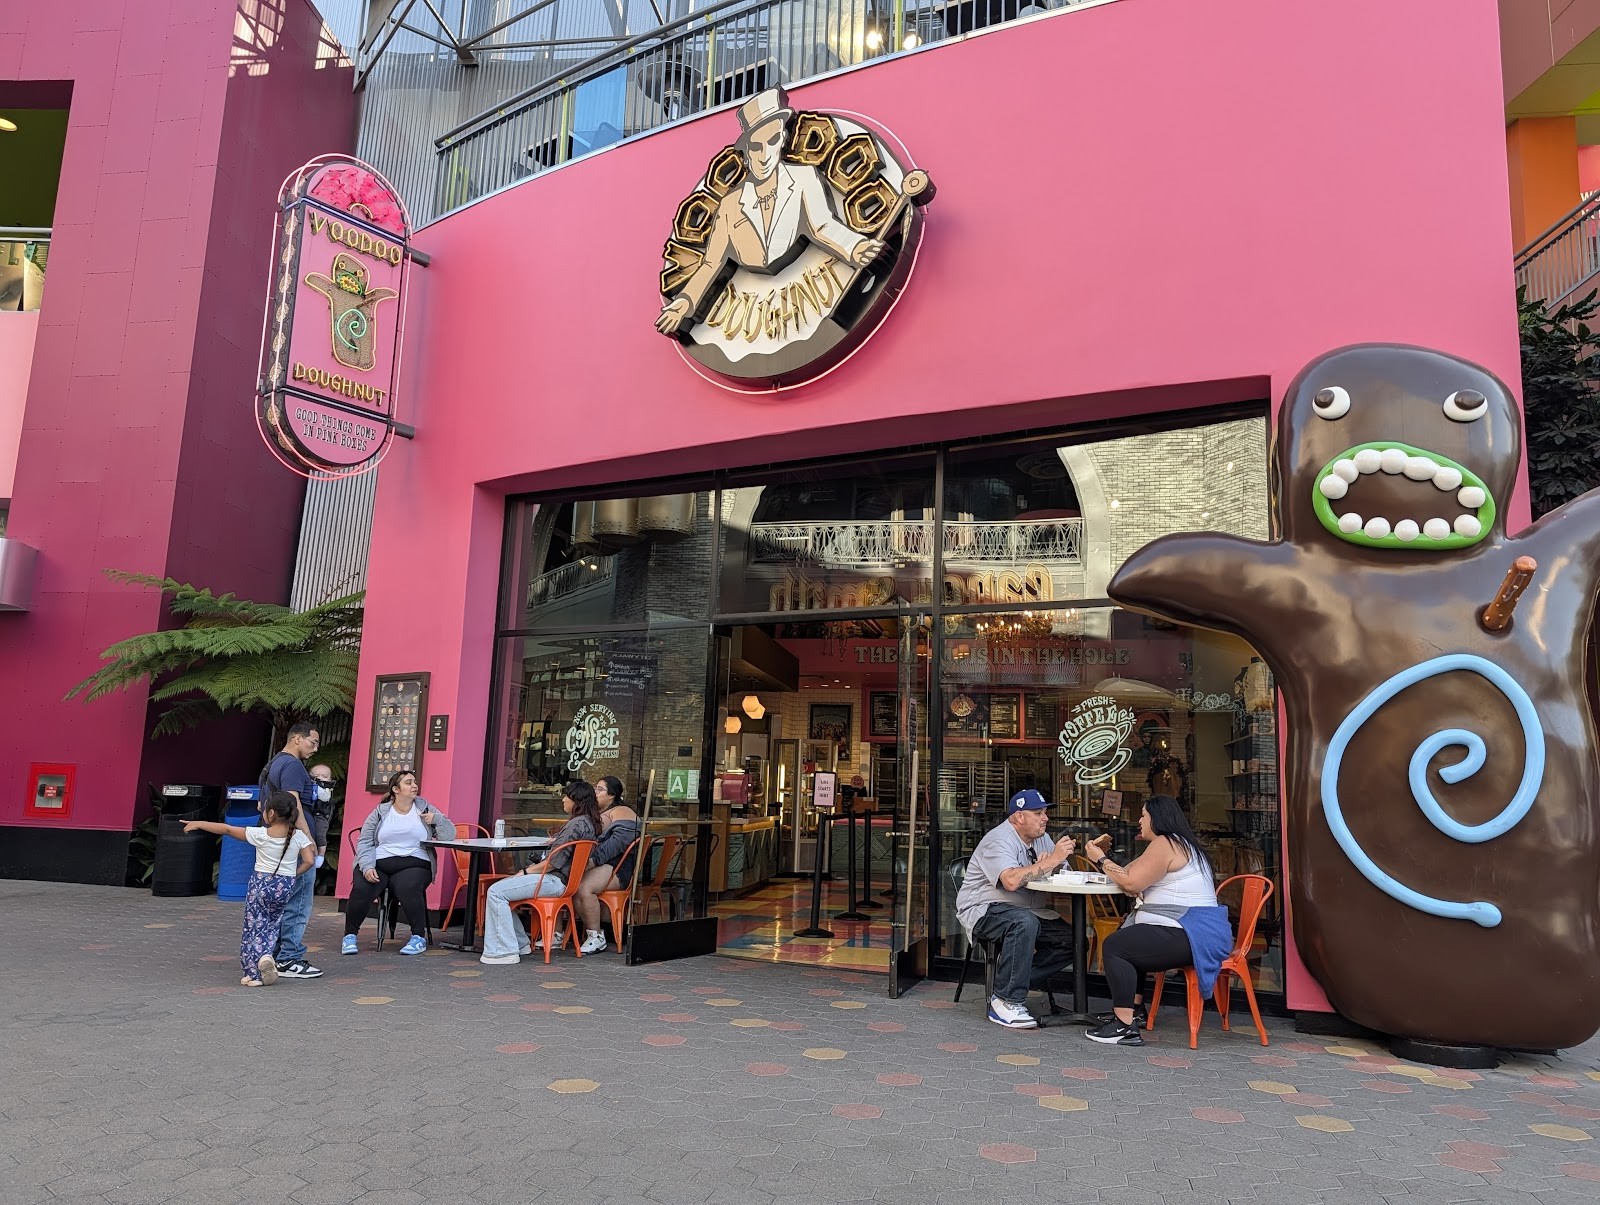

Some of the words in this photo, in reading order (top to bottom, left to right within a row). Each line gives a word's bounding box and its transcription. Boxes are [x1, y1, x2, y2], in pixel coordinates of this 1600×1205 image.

[659, 110, 898, 299] VOODOO
[308, 210, 401, 267] VOODOO
[707, 256, 846, 343] DOUGHNUT
[292, 361, 387, 406] DOUGHNUT
[295, 407, 318, 424] GOOD
[321, 414, 353, 434] THINGS
[355, 424, 377, 441] COME
[303, 423, 315, 438] IN
[316, 427, 339, 444] PINK
[341, 433, 368, 452] BOXES
[854, 646, 898, 664] THE
[992, 647, 1016, 665] IN
[1020, 647, 1065, 665] THE
[1068, 647, 1130, 665] HOLE
[573, 706, 587, 725] NOW
[589, 703, 617, 724] SERVING
[1080, 696, 1109, 711] FRESH
[1058, 704, 1117, 748] COFFEE
[592, 750, 619, 760] ESPRESSO
[670, 775, 683, 793] A
